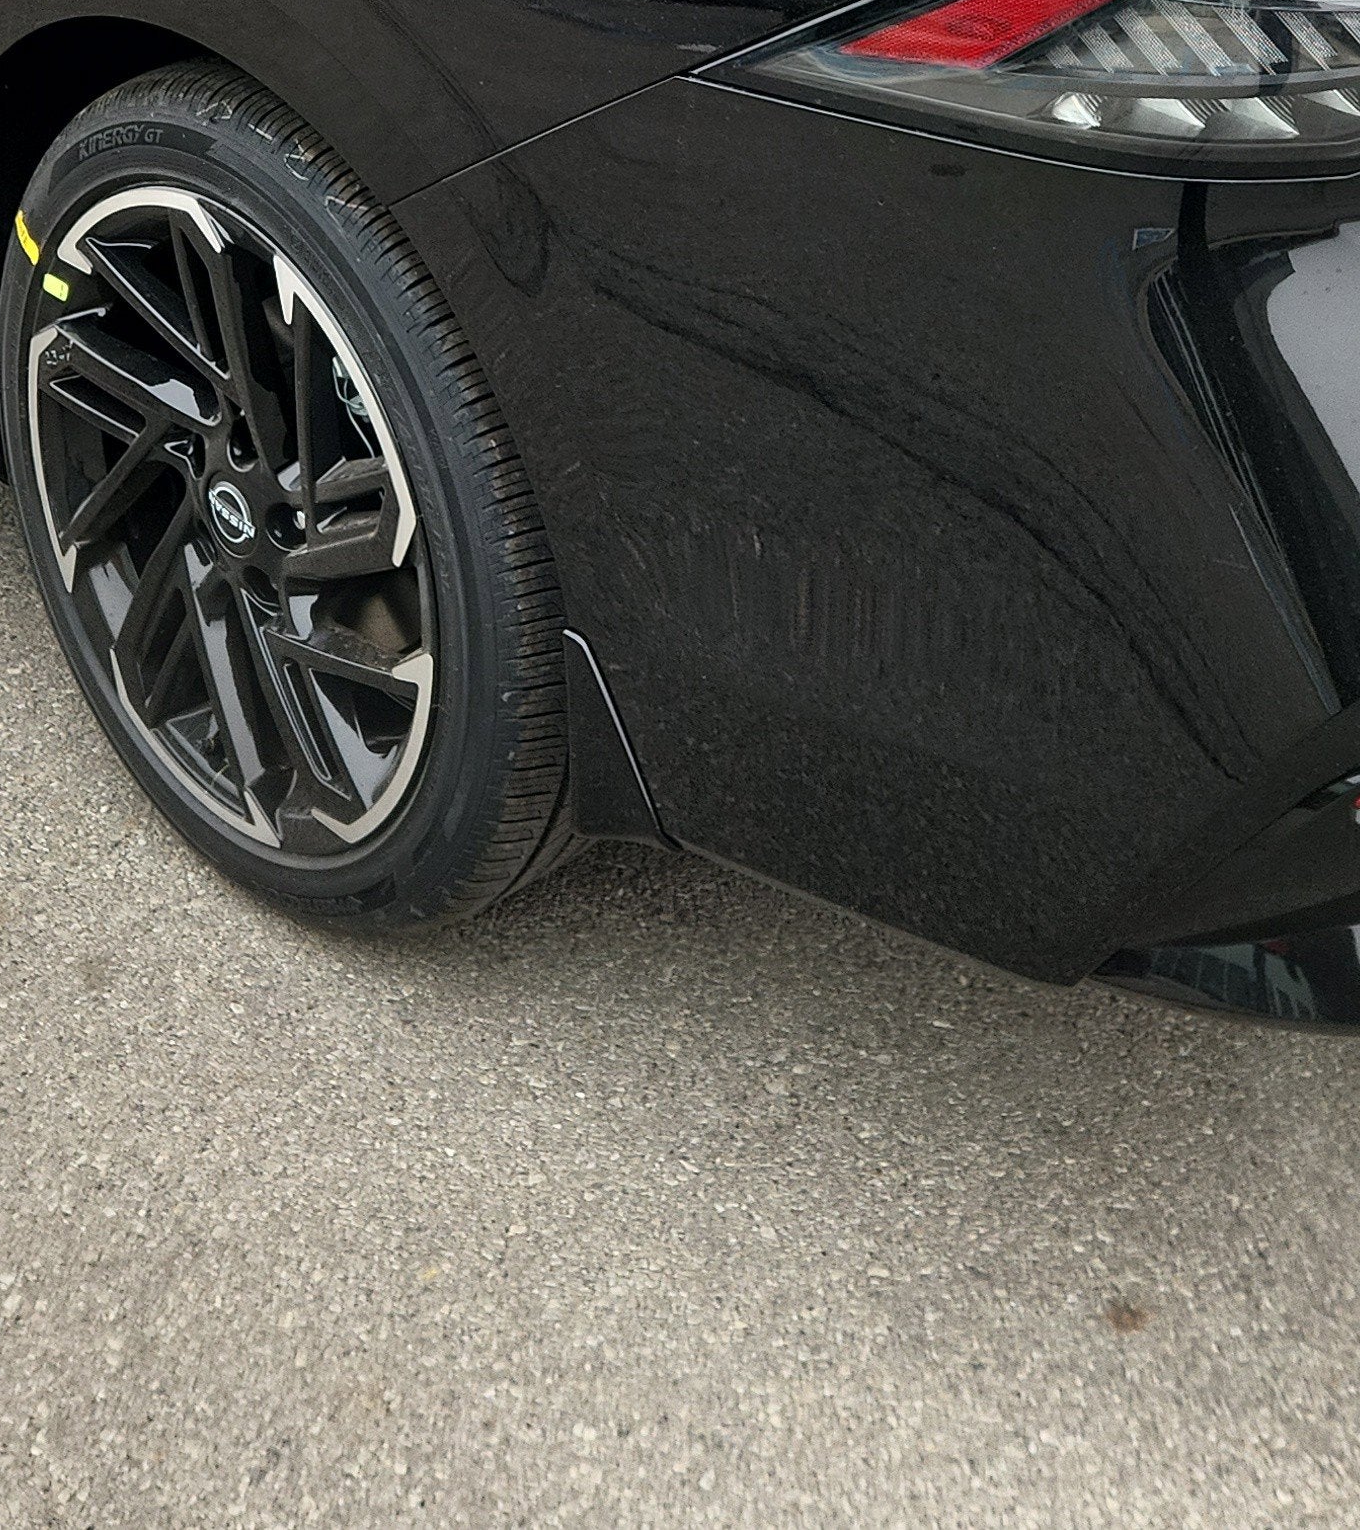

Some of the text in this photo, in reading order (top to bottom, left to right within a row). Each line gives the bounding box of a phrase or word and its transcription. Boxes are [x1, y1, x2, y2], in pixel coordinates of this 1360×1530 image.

[79, 124, 163, 161] KINERGY GT
[208, 489, 256, 539] NISSAN
